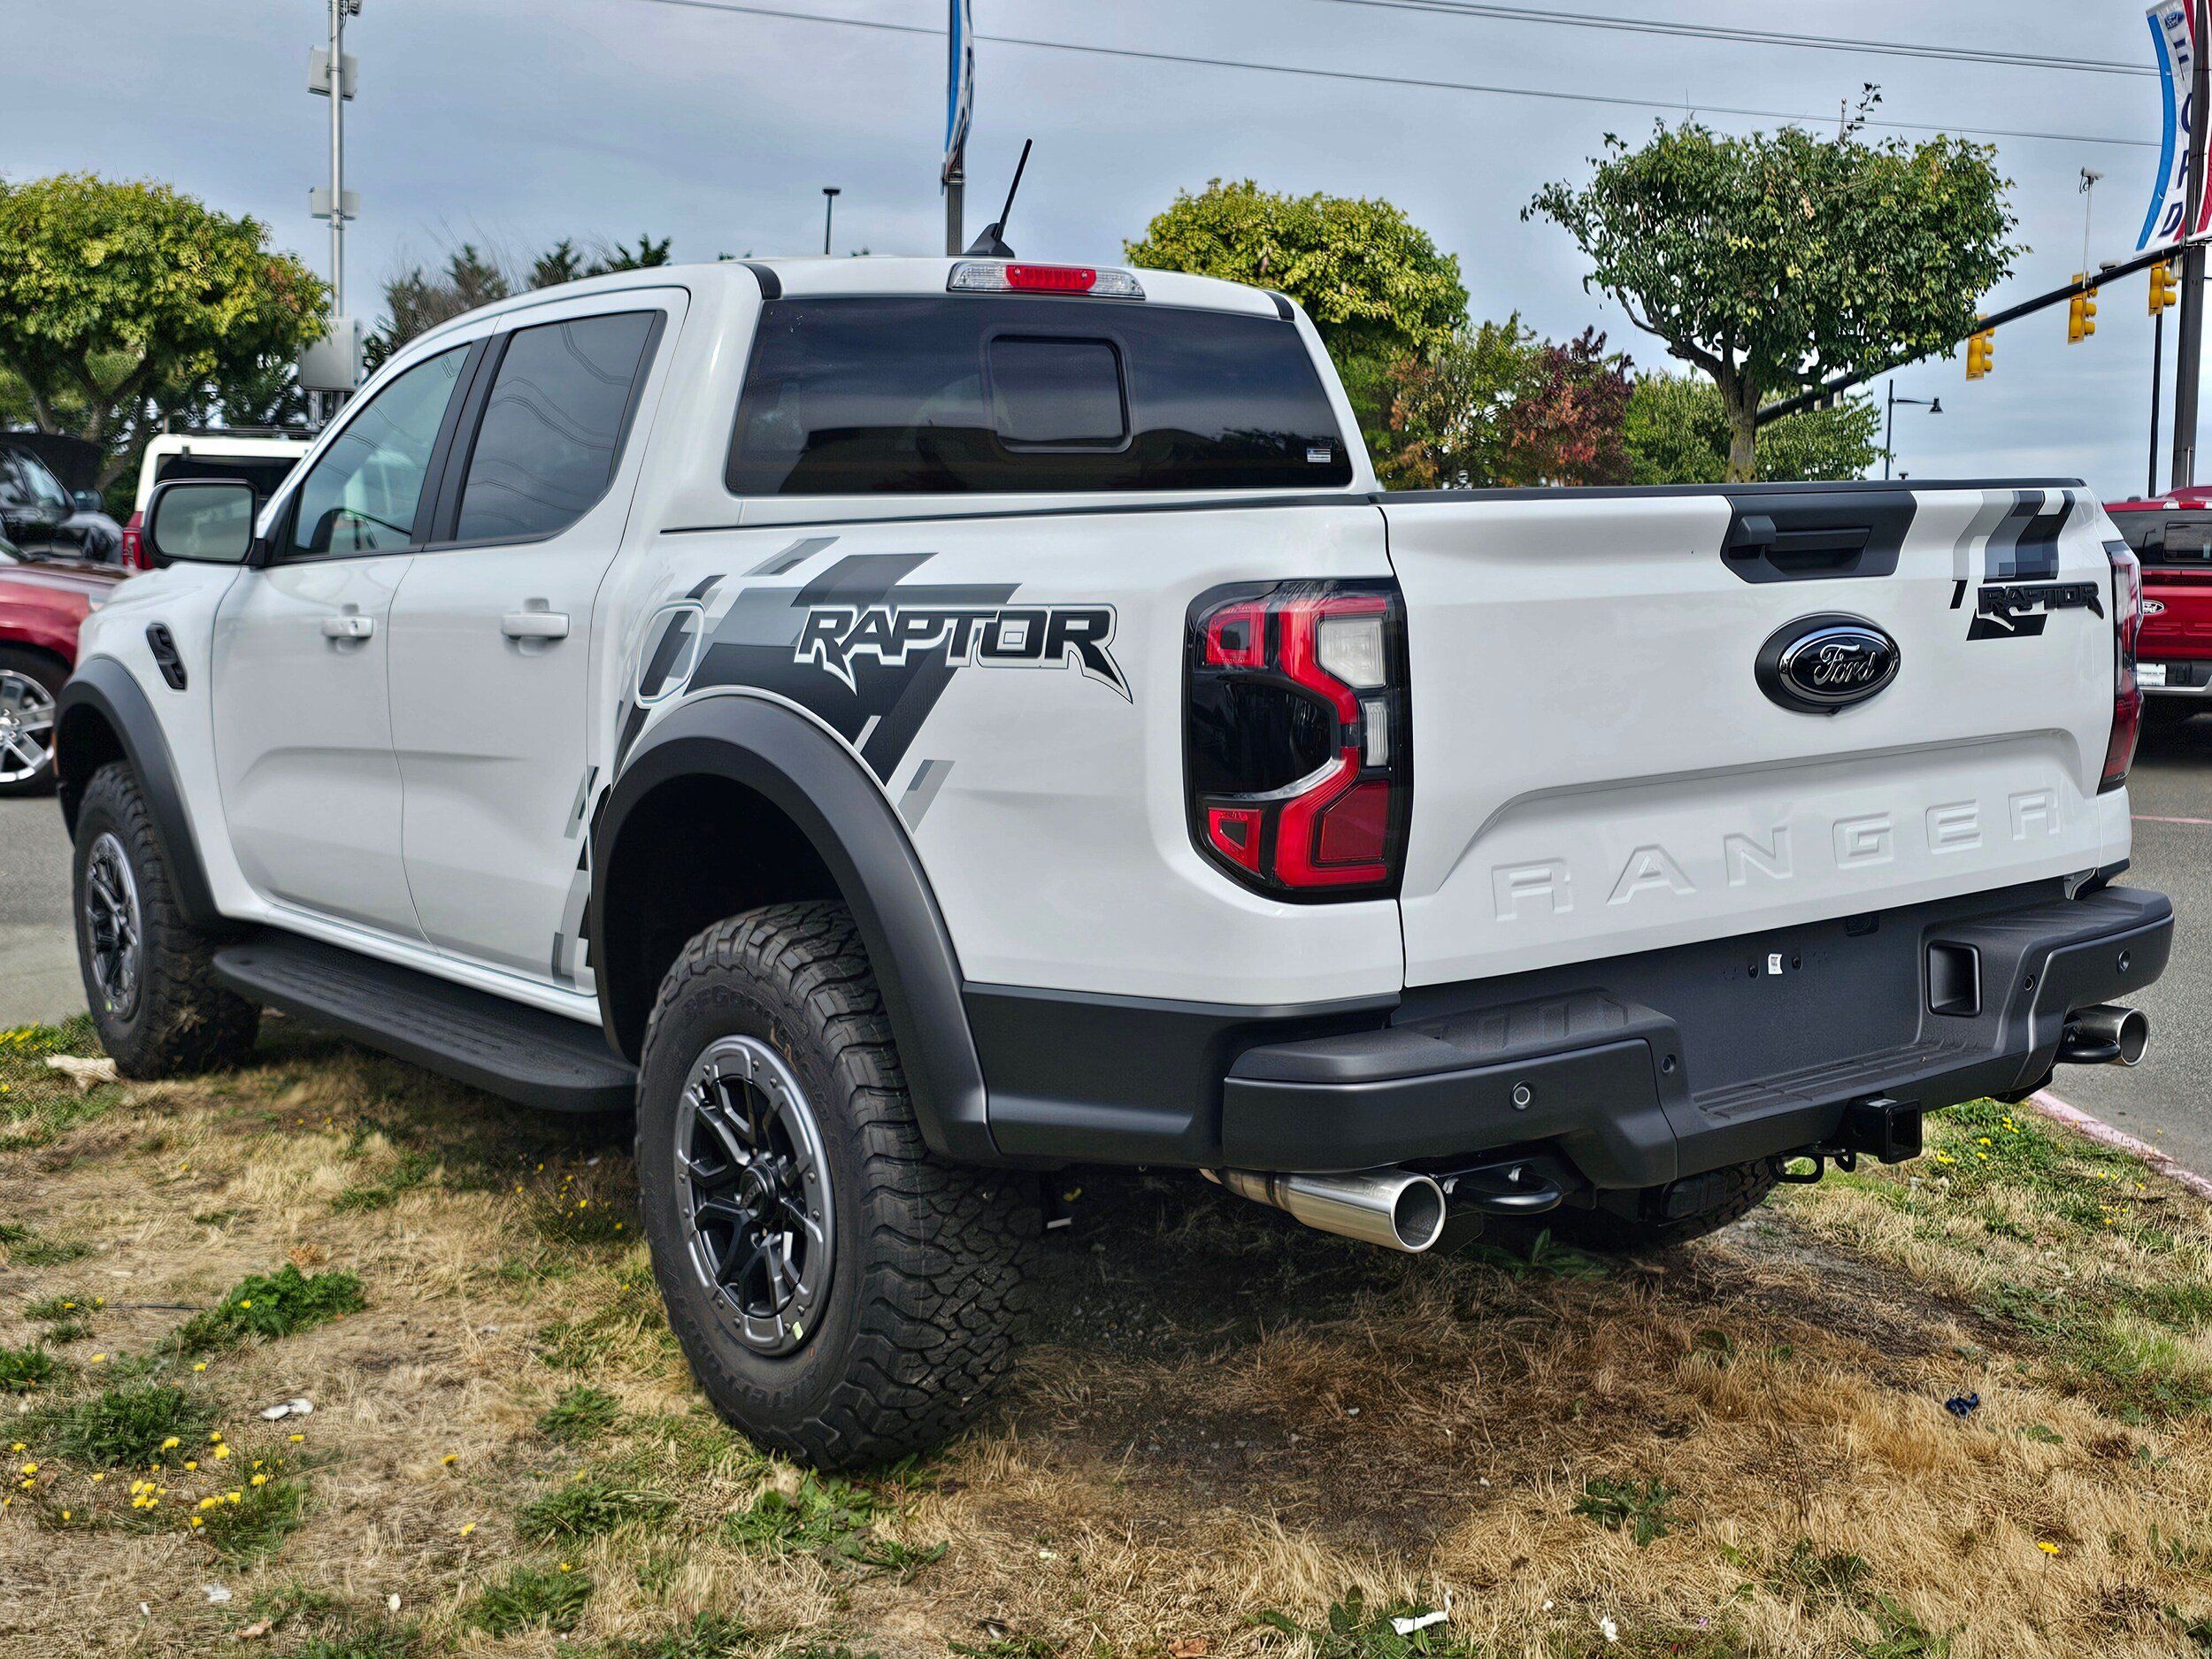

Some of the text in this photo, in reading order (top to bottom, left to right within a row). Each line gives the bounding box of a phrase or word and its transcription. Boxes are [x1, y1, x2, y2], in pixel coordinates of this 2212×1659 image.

[1977, 580, 2105, 631] RAPTOR
[794, 603, 1133, 705] RAPTOR
[1813, 642, 1876, 685] Ford
[1491, 786, 2062, 921] RANGER
